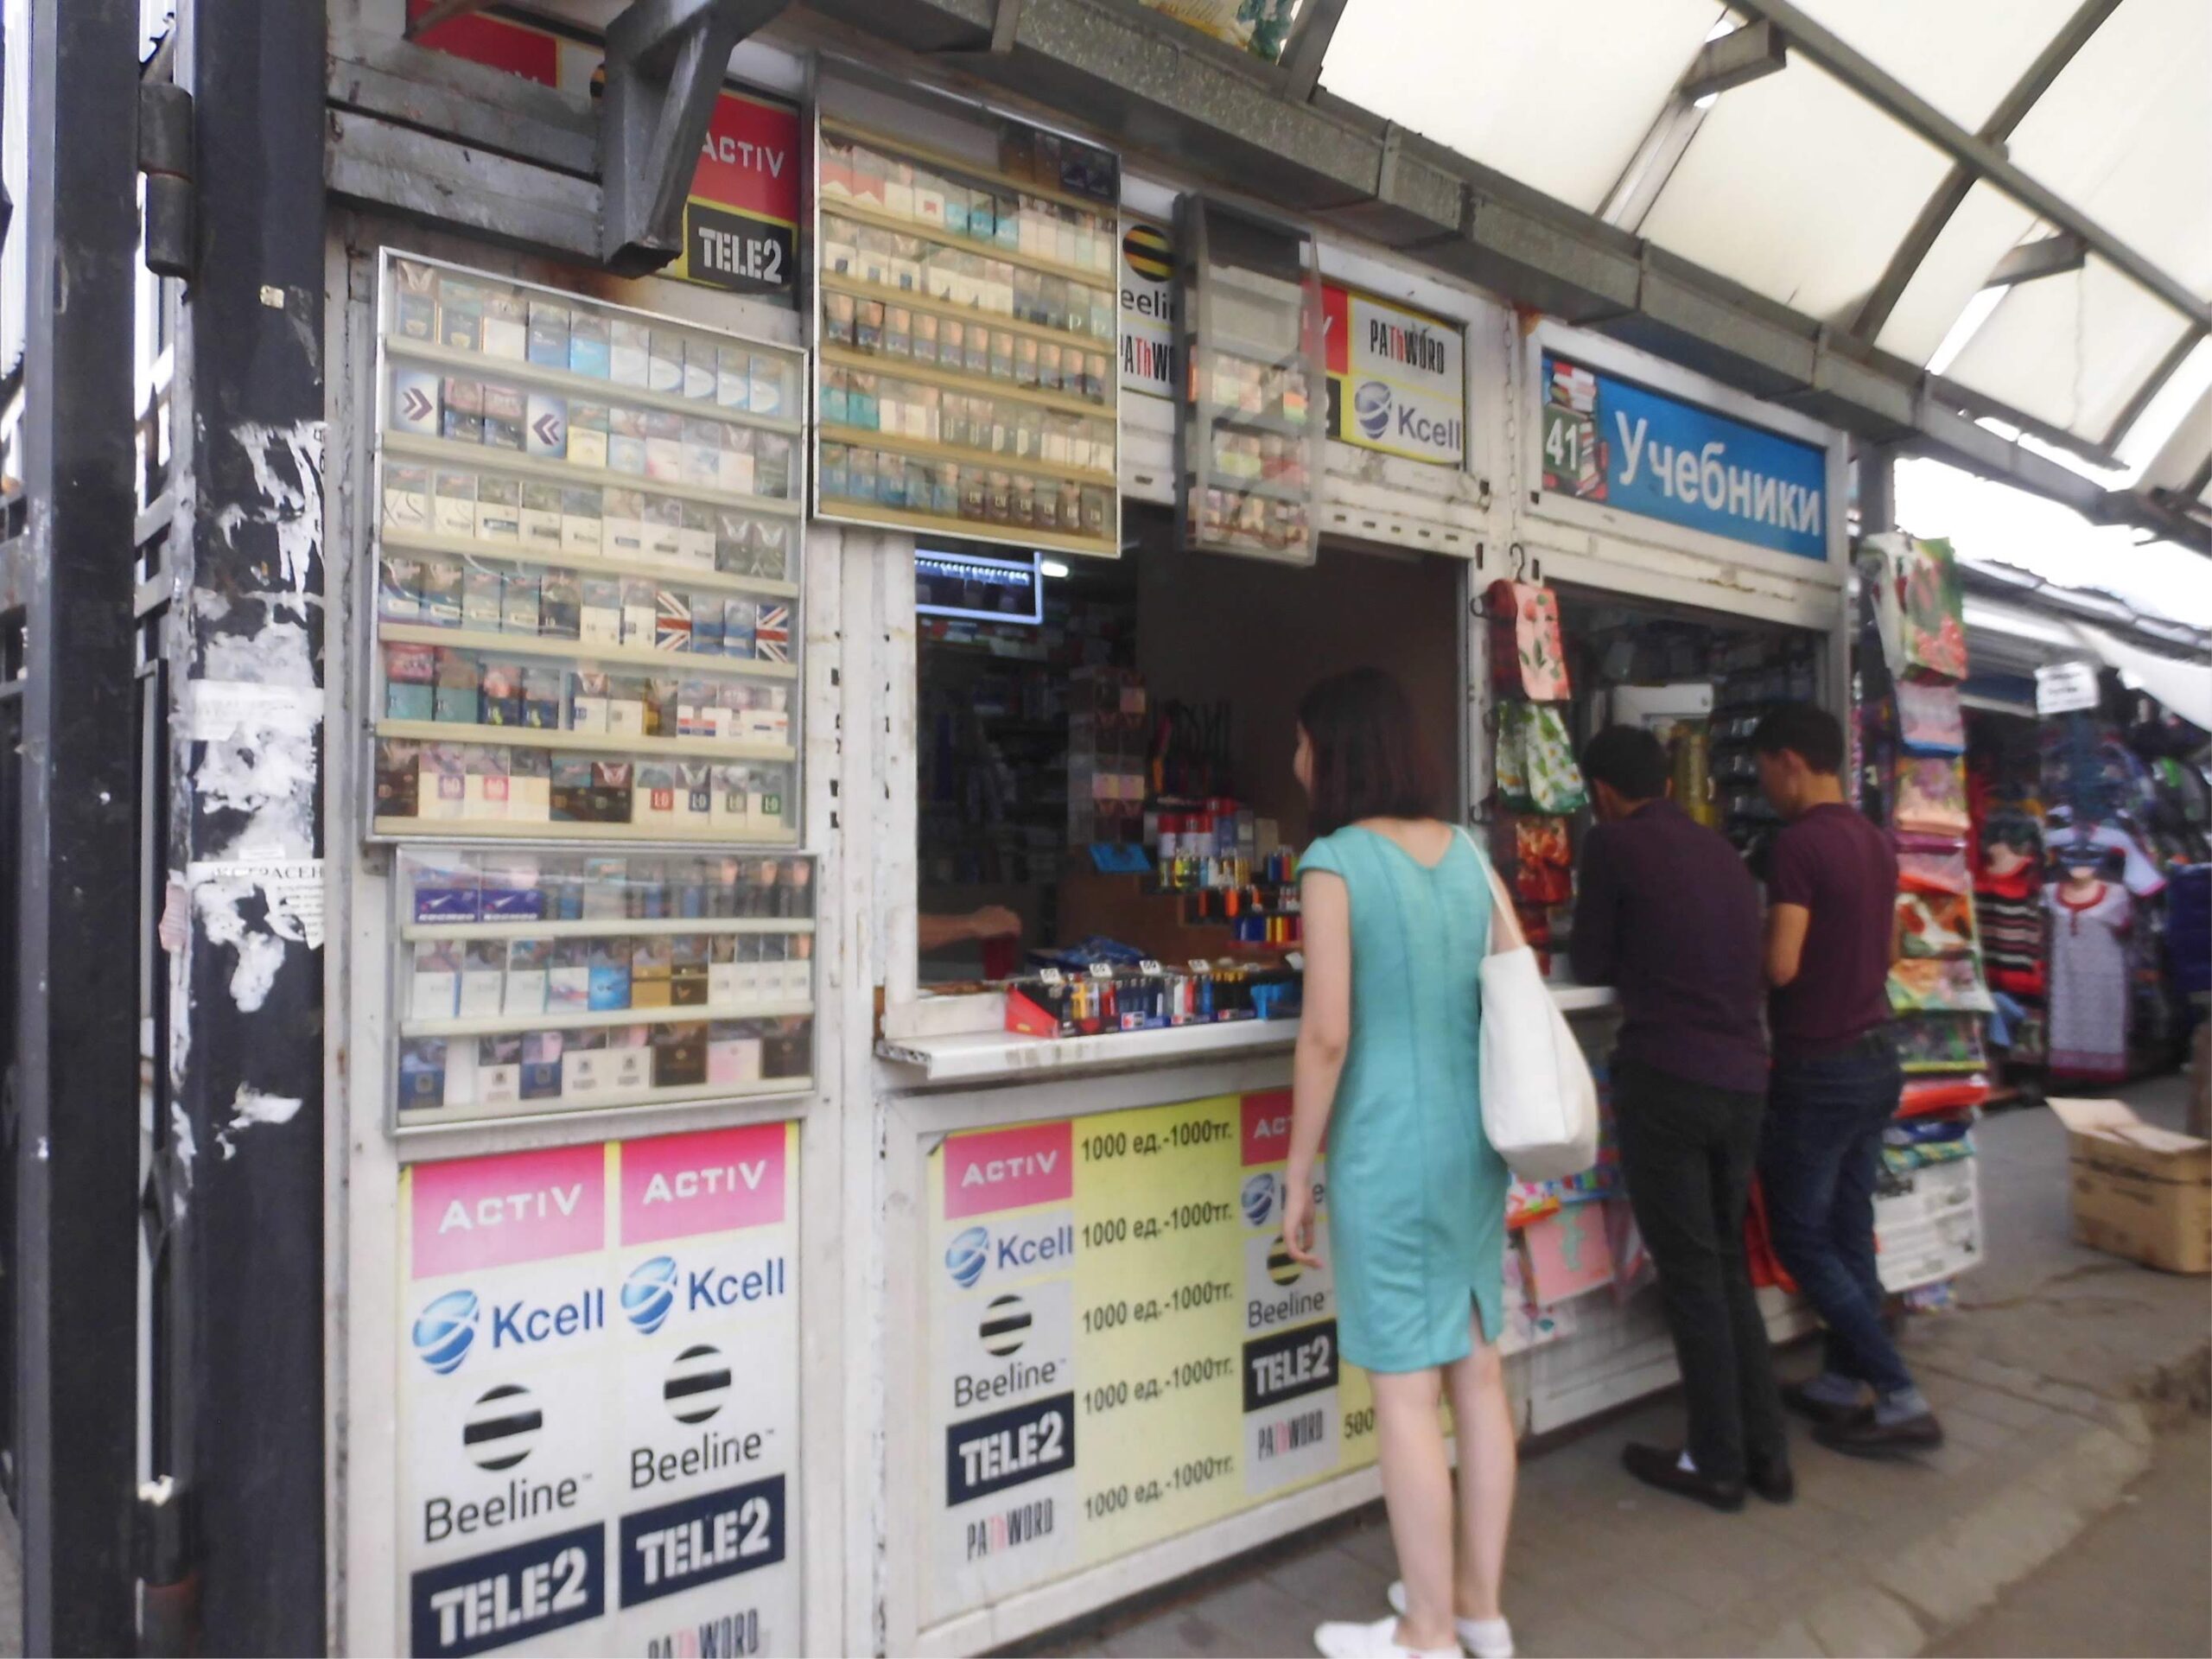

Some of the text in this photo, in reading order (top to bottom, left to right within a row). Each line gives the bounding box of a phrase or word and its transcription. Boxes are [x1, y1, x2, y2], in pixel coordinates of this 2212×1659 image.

[701, 130, 785, 179] ACTIV
[698, 226, 783, 283] TELE2
[1398, 404, 1461, 449] Kcell
[1545, 417, 1578, 472] 41
[1615, 410, 1820, 537] Учебники
[961, 1149, 1058, 1189] ACTIV
[1082, 1131, 1127, 1162] 1000
[642, 1160, 766, 1205] ACTIV
[437, 1183, 584, 1235] ACTIV
[1082, 1217, 1127, 1249] 1000
[997, 1224, 1072, 1270] Kcell
[688, 1256, 785, 1312] Kcell
[492, 1287, 604, 1350] Kcell
[1082, 1300, 1127, 1334] 1000
[1247, 1291, 1325, 1330] Beeline
[954, 1360, 1057, 1408] Beeline
[1252, 1334, 1331, 1395] TELE2
[1083, 1381, 1127, 1415] 1000
[958, 1410, 1064, 1487] TELE2
[1084, 1487, 1127, 1522] 1000
[635, 1496, 772, 1586] TELE2
[430, 1546, 589, 1648] TELE2
